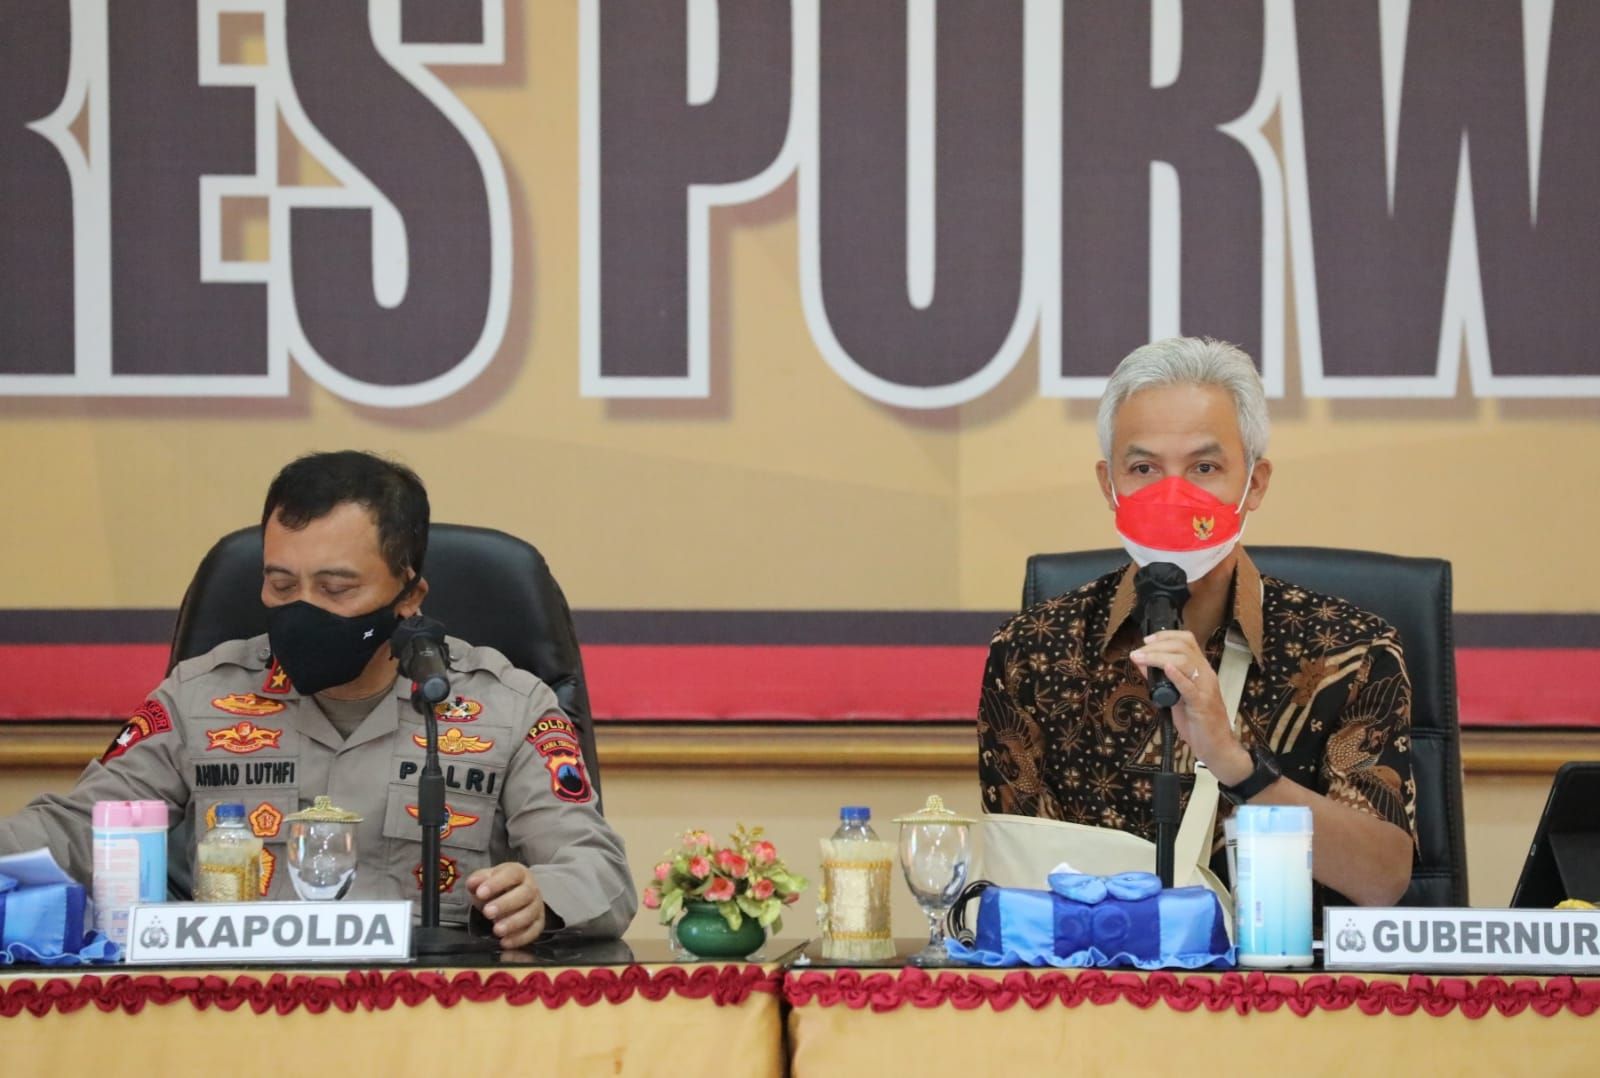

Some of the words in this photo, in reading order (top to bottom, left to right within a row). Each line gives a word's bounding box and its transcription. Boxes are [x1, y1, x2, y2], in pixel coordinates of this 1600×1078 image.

[529, 719, 572, 737] POLDA
[195, 763, 239, 787] AHMAD
[245, 762, 295, 785] LUTHFI
[399, 761, 496, 794] PLRI
[175, 913, 394, 949] KAPOLDA
[1372, 920, 1600, 956] GUBERNUR
